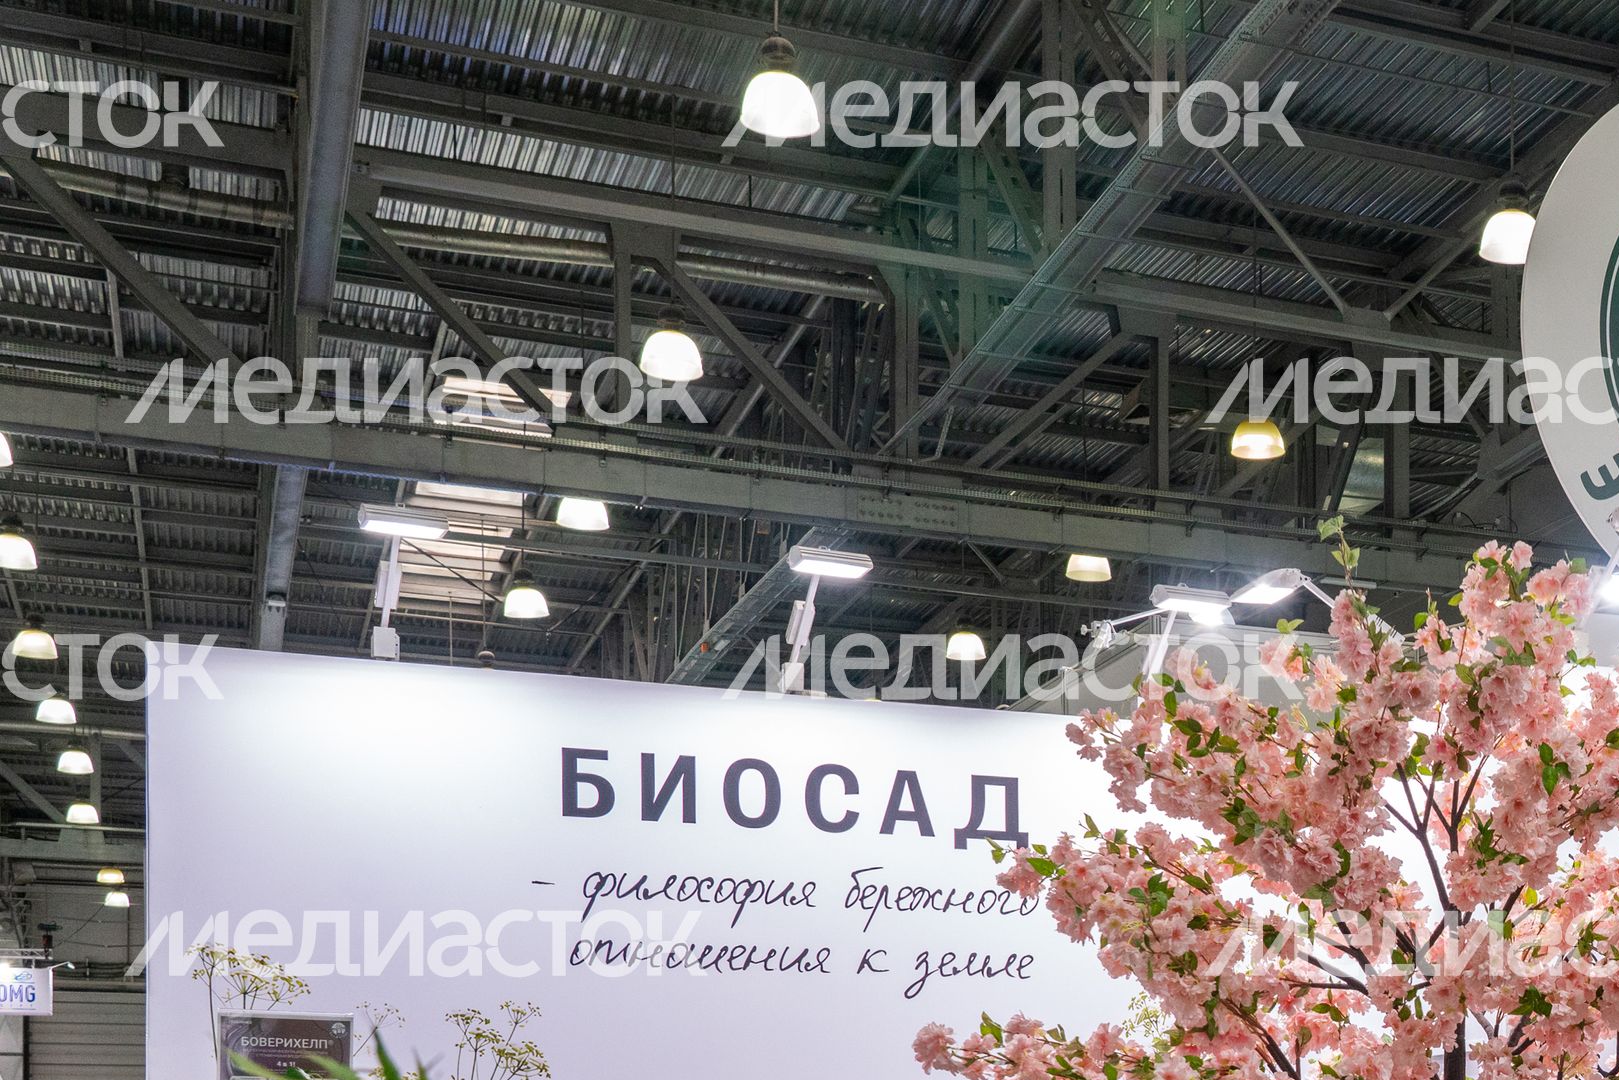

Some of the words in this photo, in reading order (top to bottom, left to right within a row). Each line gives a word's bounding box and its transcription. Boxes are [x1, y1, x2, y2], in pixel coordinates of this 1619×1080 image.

[561, 747, 1030, 850] БИОСАД
[582, 871, 816, 928] философия
[845, 866, 1039, 932] бережного
[570, 938, 831, 975] отношения
[856, 949, 890, 974] к
[904, 949, 1034, 999] земле
